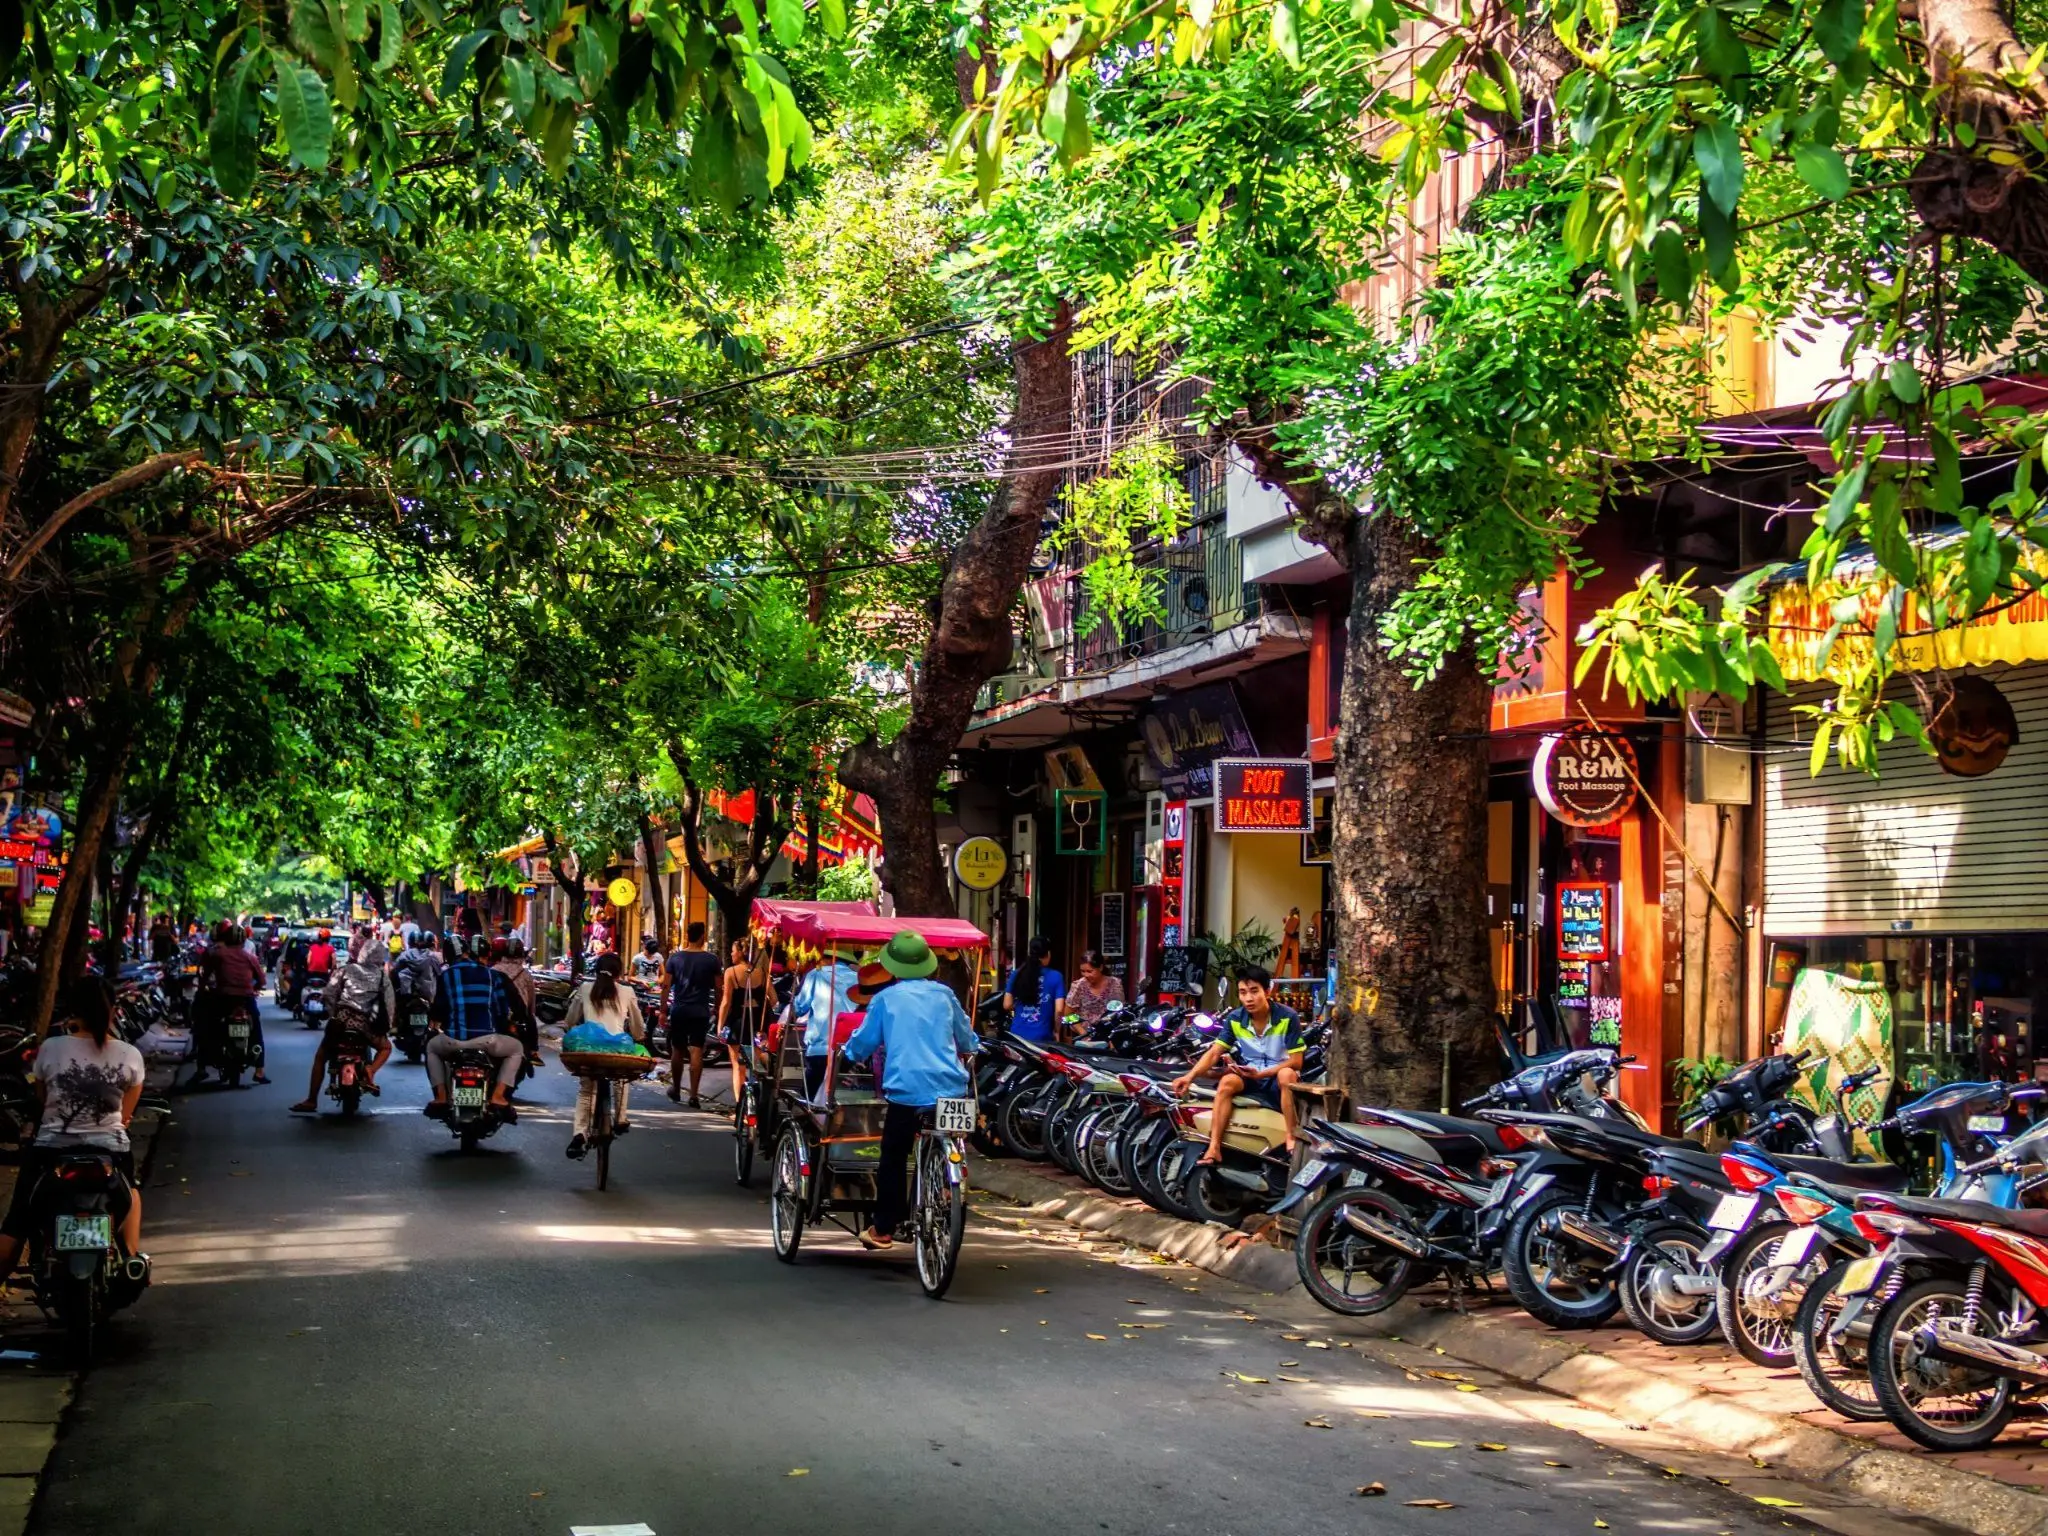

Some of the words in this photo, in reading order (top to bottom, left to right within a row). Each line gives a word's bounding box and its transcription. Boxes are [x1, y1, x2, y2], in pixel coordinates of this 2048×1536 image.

[1558, 756, 1625, 779] R&M
[1242, 769, 1285, 795] FOOT
[1558, 781, 1579, 791] Foot
[1582, 781, 1626, 792] Massage
[1228, 799, 1302, 826] MASSAGE
[943, 1100, 969, 1115] 29XL
[940, 1115, 972, 1130] 0126
